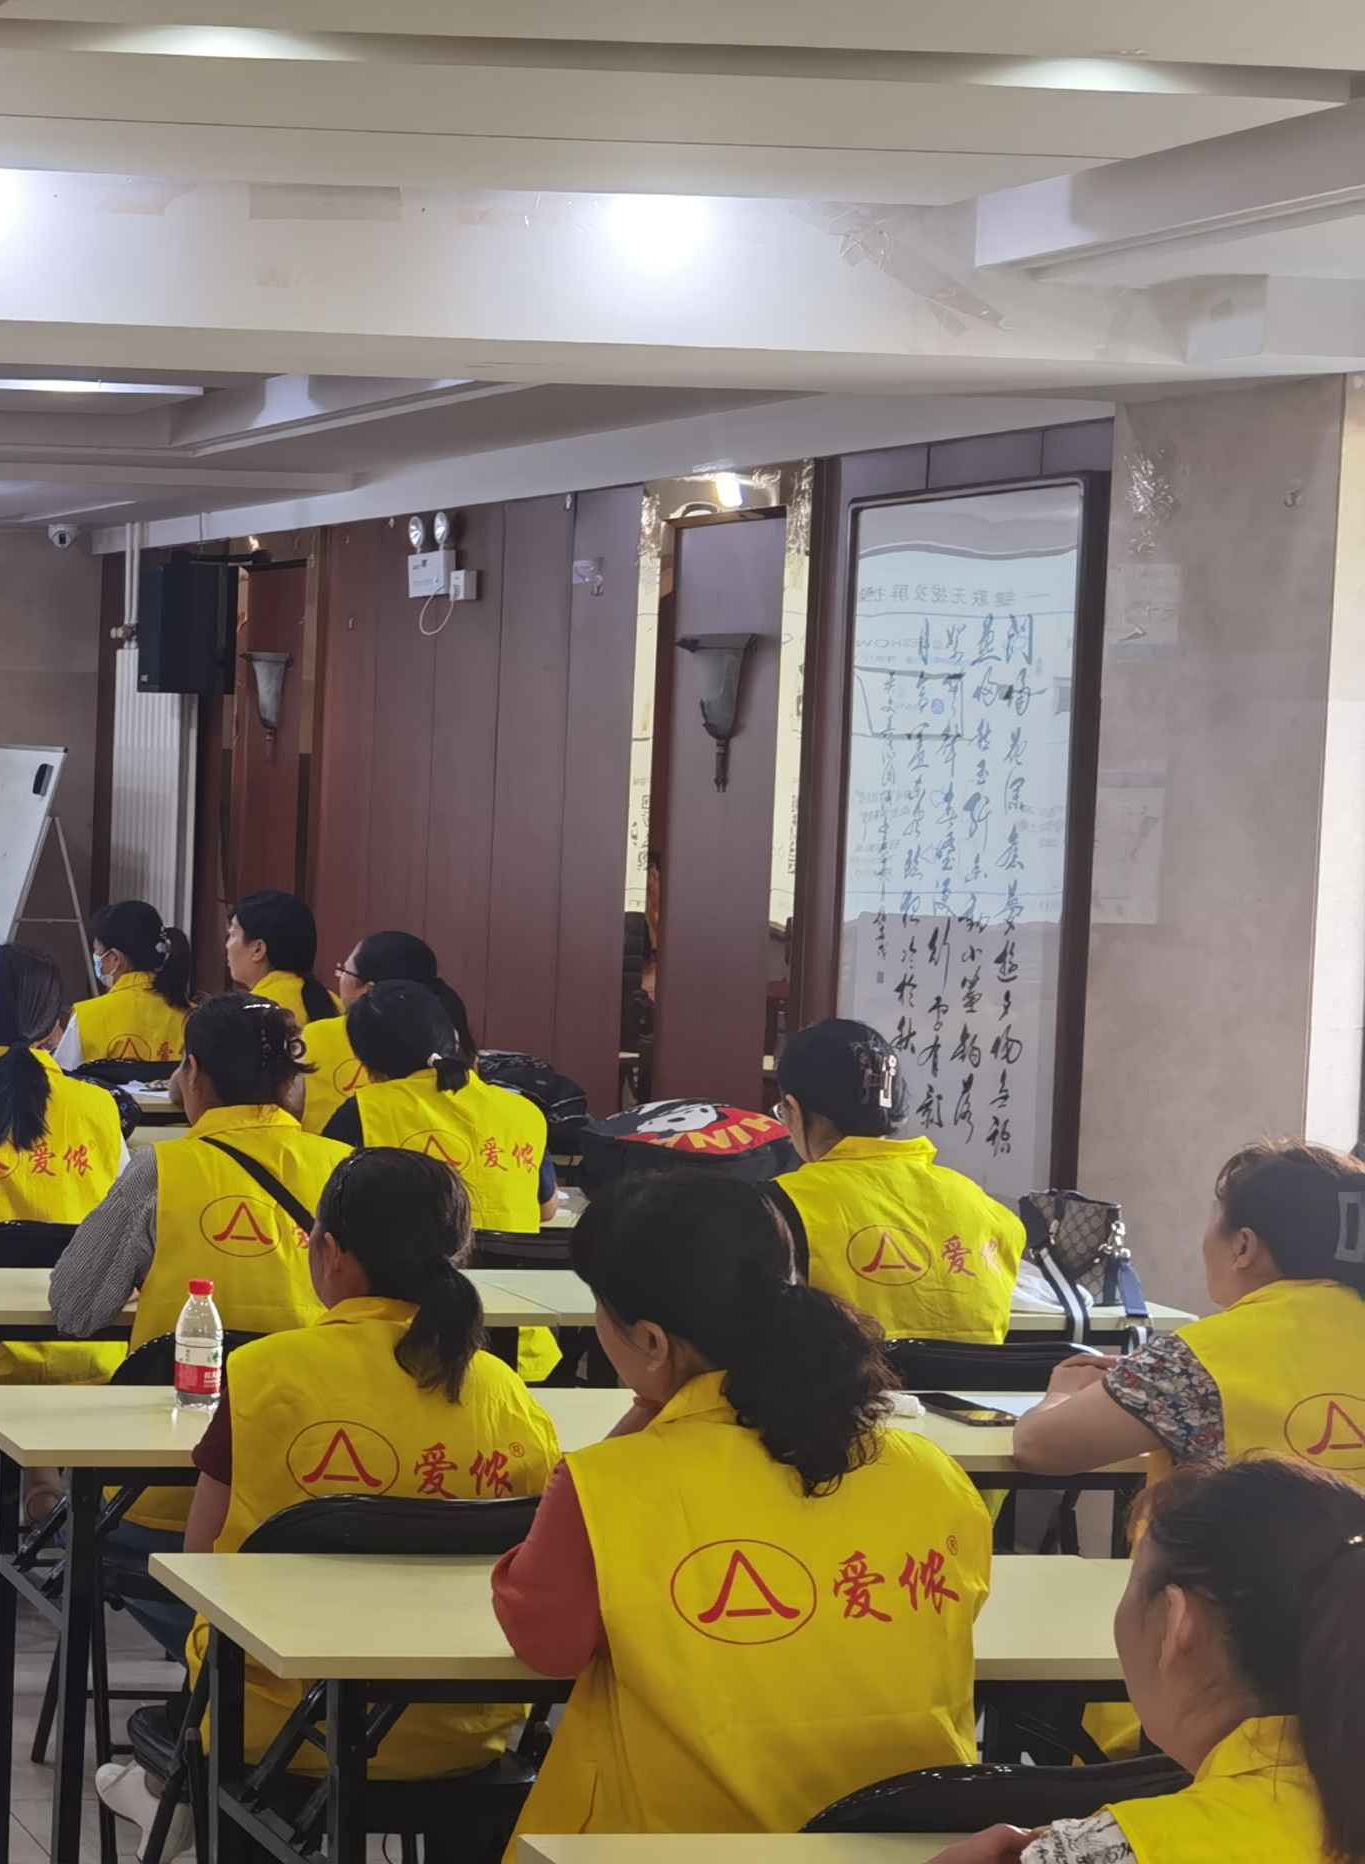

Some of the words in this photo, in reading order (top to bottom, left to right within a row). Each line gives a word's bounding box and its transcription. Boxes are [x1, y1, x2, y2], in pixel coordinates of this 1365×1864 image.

[28, 1143, 91, 1178] 爱侬
[480, 1136, 539, 1175] 爱侬
[413, 1441, 514, 1500] 爱侬
[832, 1550, 961, 1623] 爱侬
